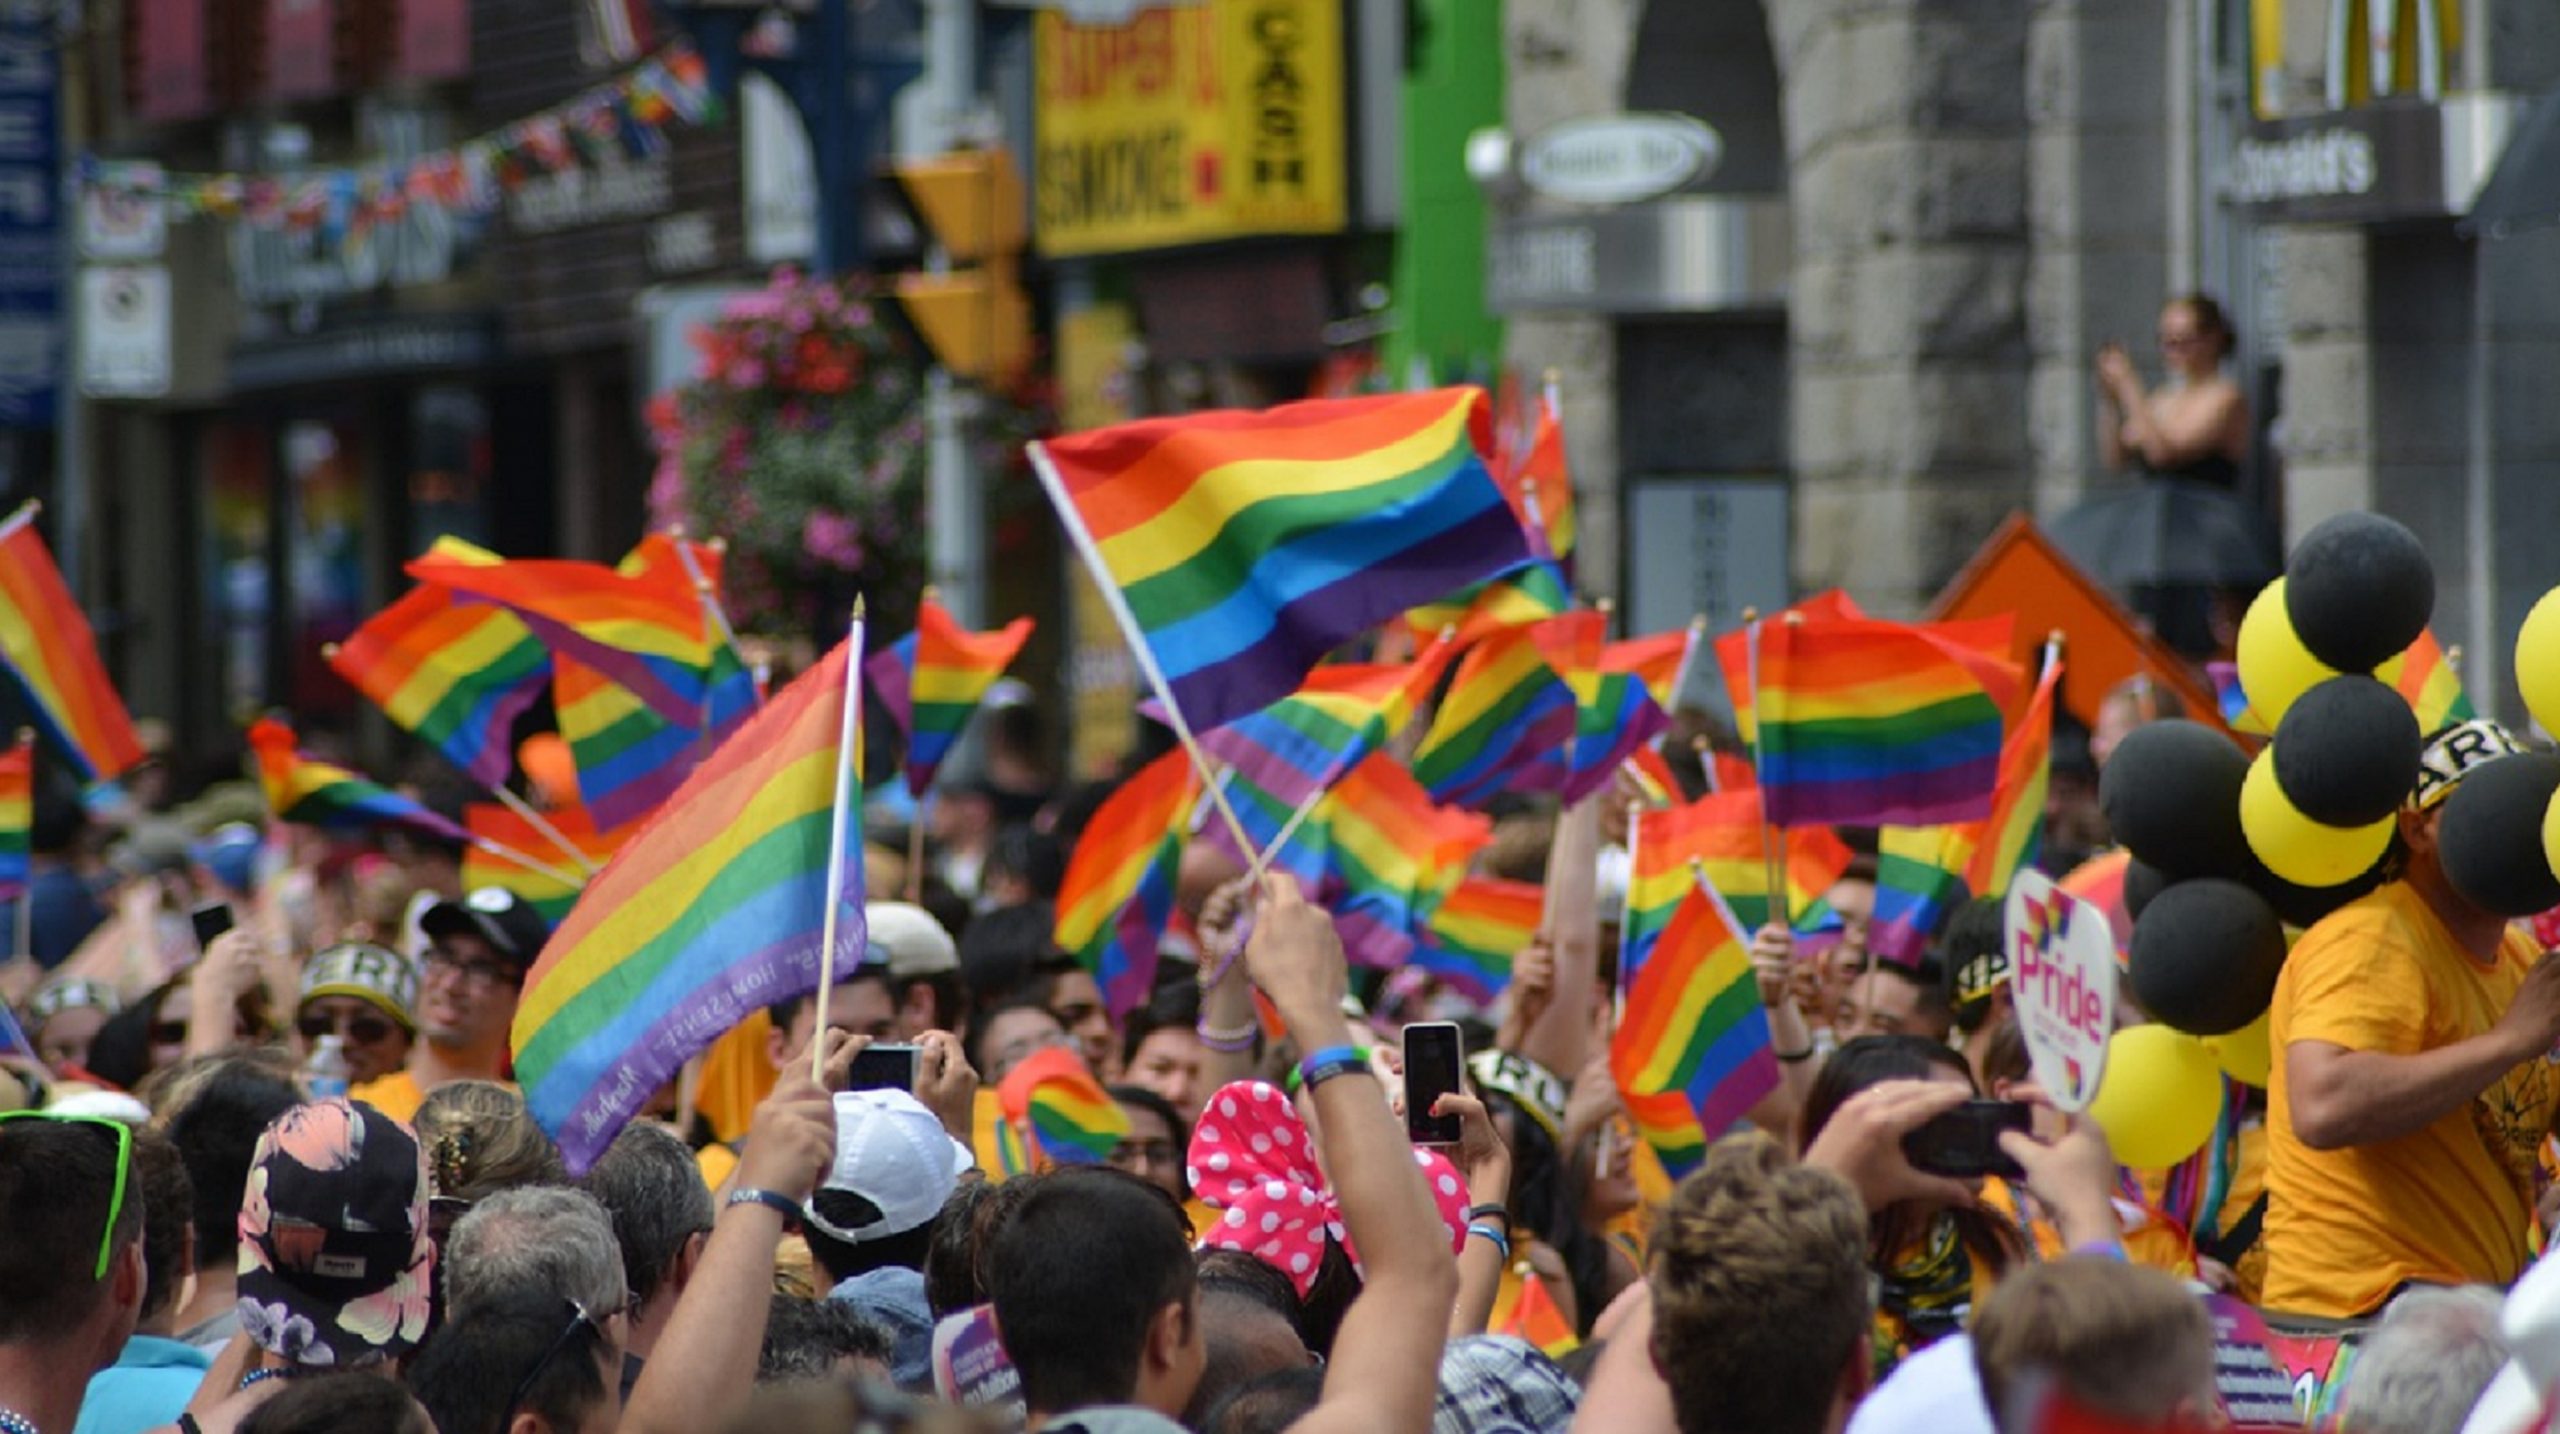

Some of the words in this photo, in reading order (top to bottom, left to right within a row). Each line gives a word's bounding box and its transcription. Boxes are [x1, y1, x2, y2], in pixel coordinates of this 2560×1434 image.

[1247, 5, 1306, 194] CASH
[2414, 724, 2516, 808] AR
[2017, 928, 2104, 1047] Pride
